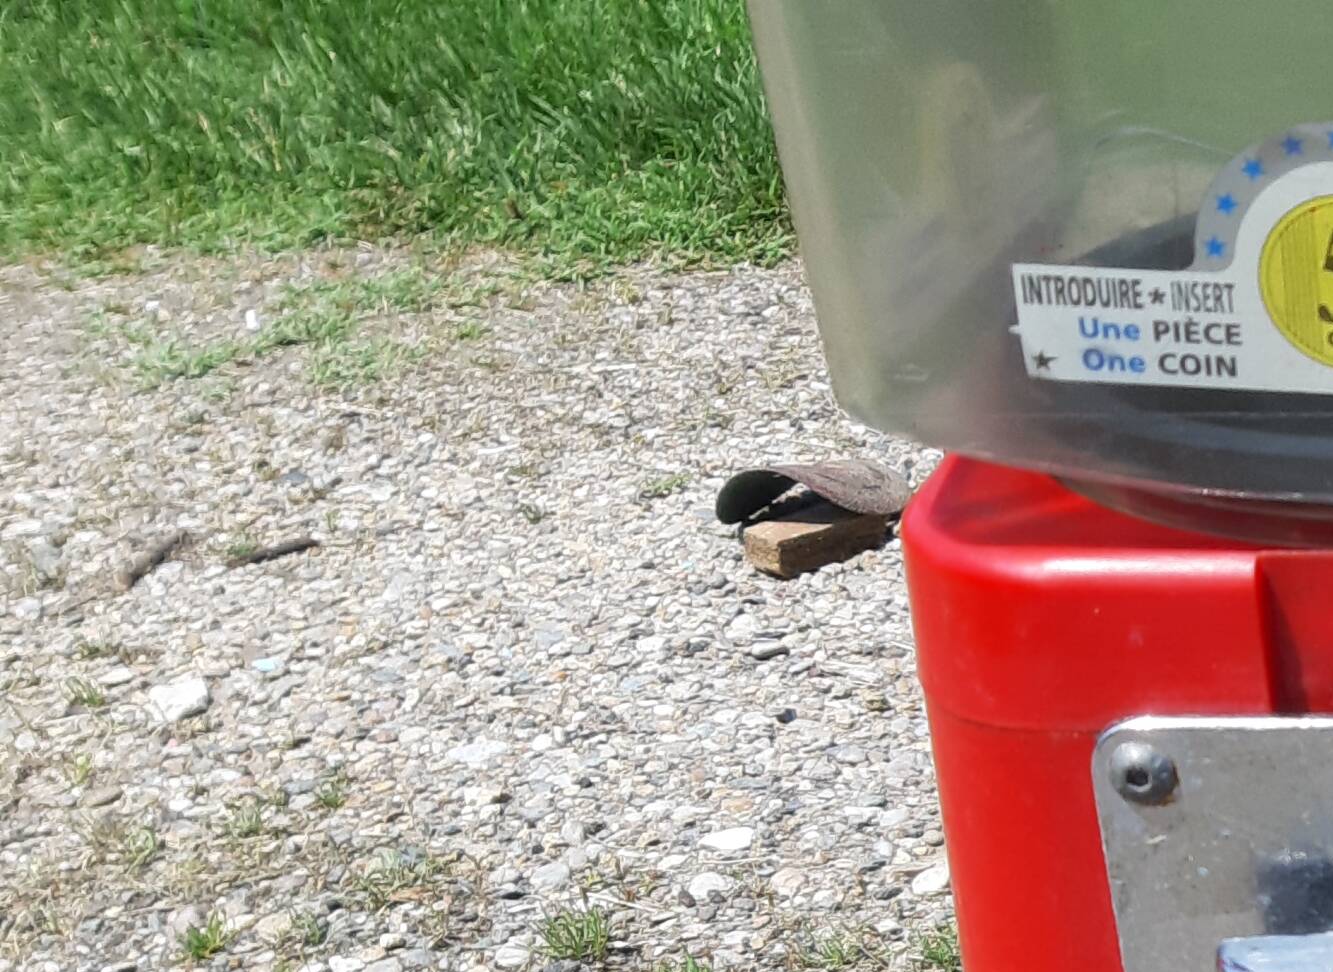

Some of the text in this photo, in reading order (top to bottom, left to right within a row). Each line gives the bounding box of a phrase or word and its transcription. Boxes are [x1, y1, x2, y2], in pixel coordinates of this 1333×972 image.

[1020, 274, 1236, 315] INTRODUIRE INSERT
[1078, 314, 1243, 346] Une PIÈCE
[1082, 348, 1238, 378] One COIN
